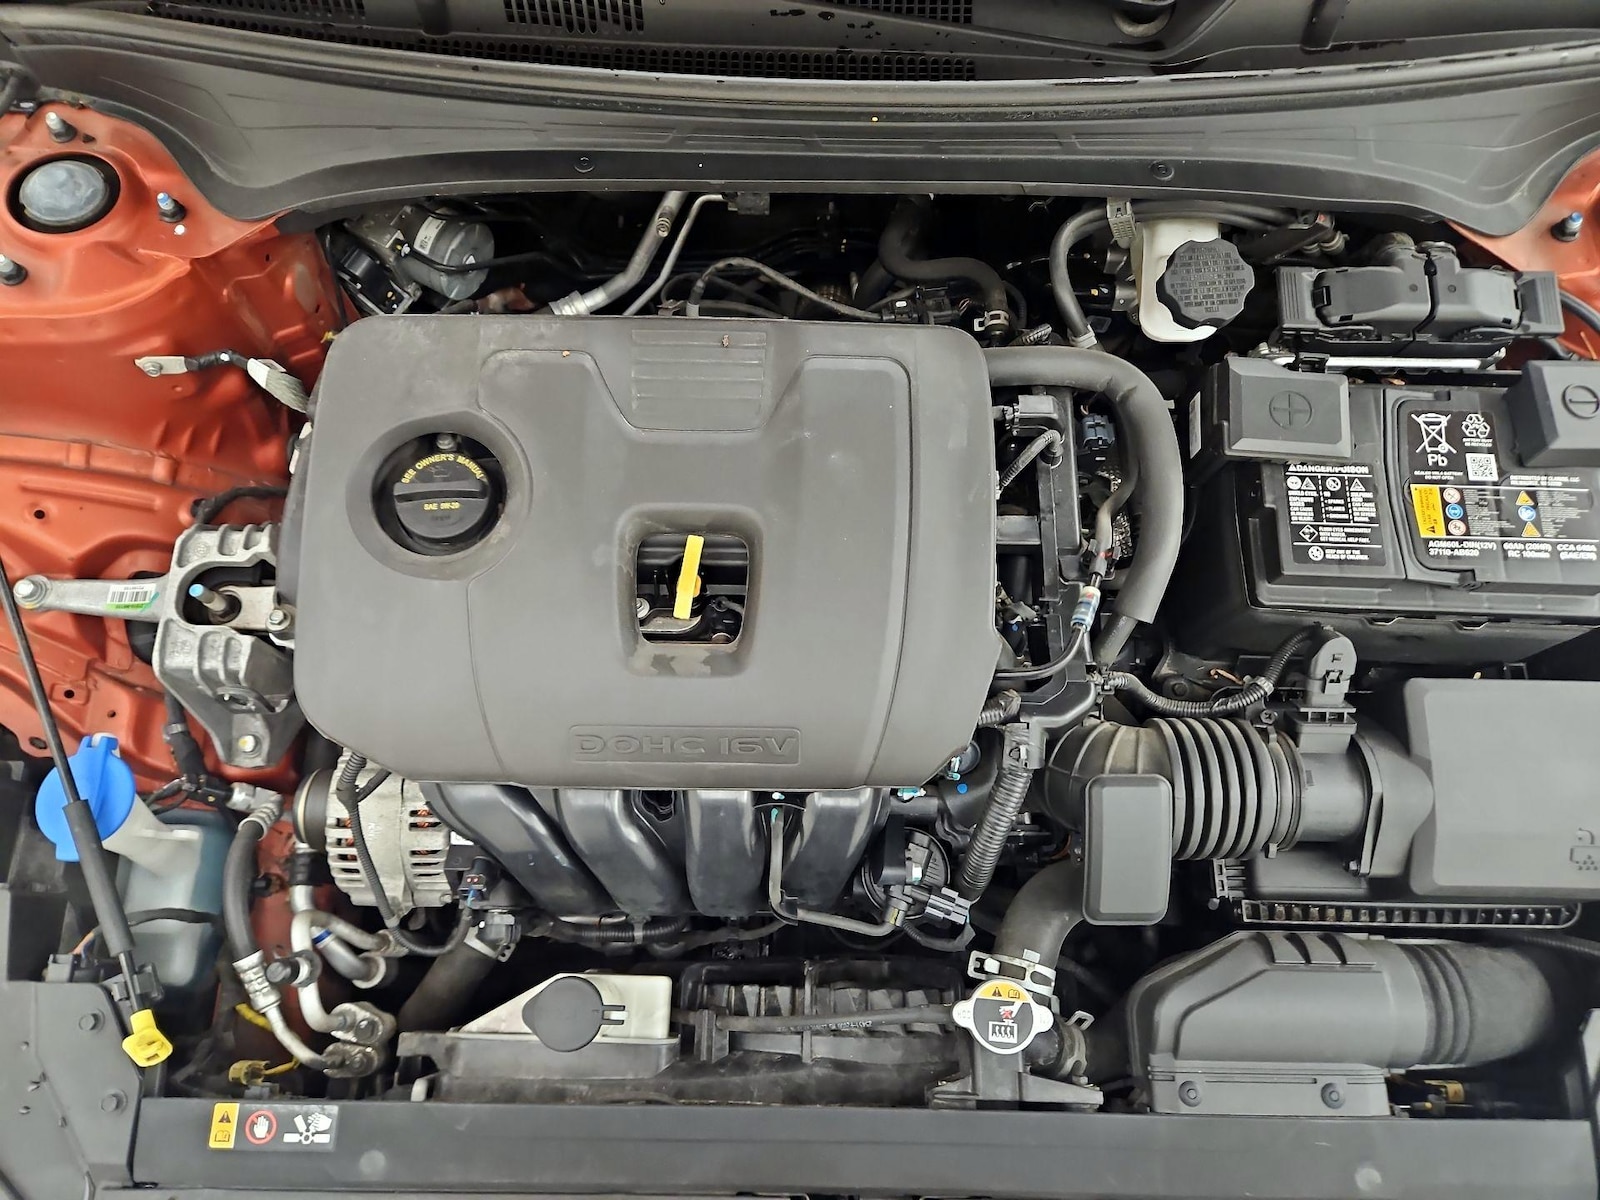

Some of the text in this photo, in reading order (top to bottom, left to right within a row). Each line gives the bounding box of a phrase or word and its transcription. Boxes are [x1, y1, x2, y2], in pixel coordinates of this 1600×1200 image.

[401, 468, 416, 483] SEE
[415, 454, 454, 469] OWNER'S
[1428, 454, 1448, 466] Pb
[575, 734, 796, 755] DOHC 16V
